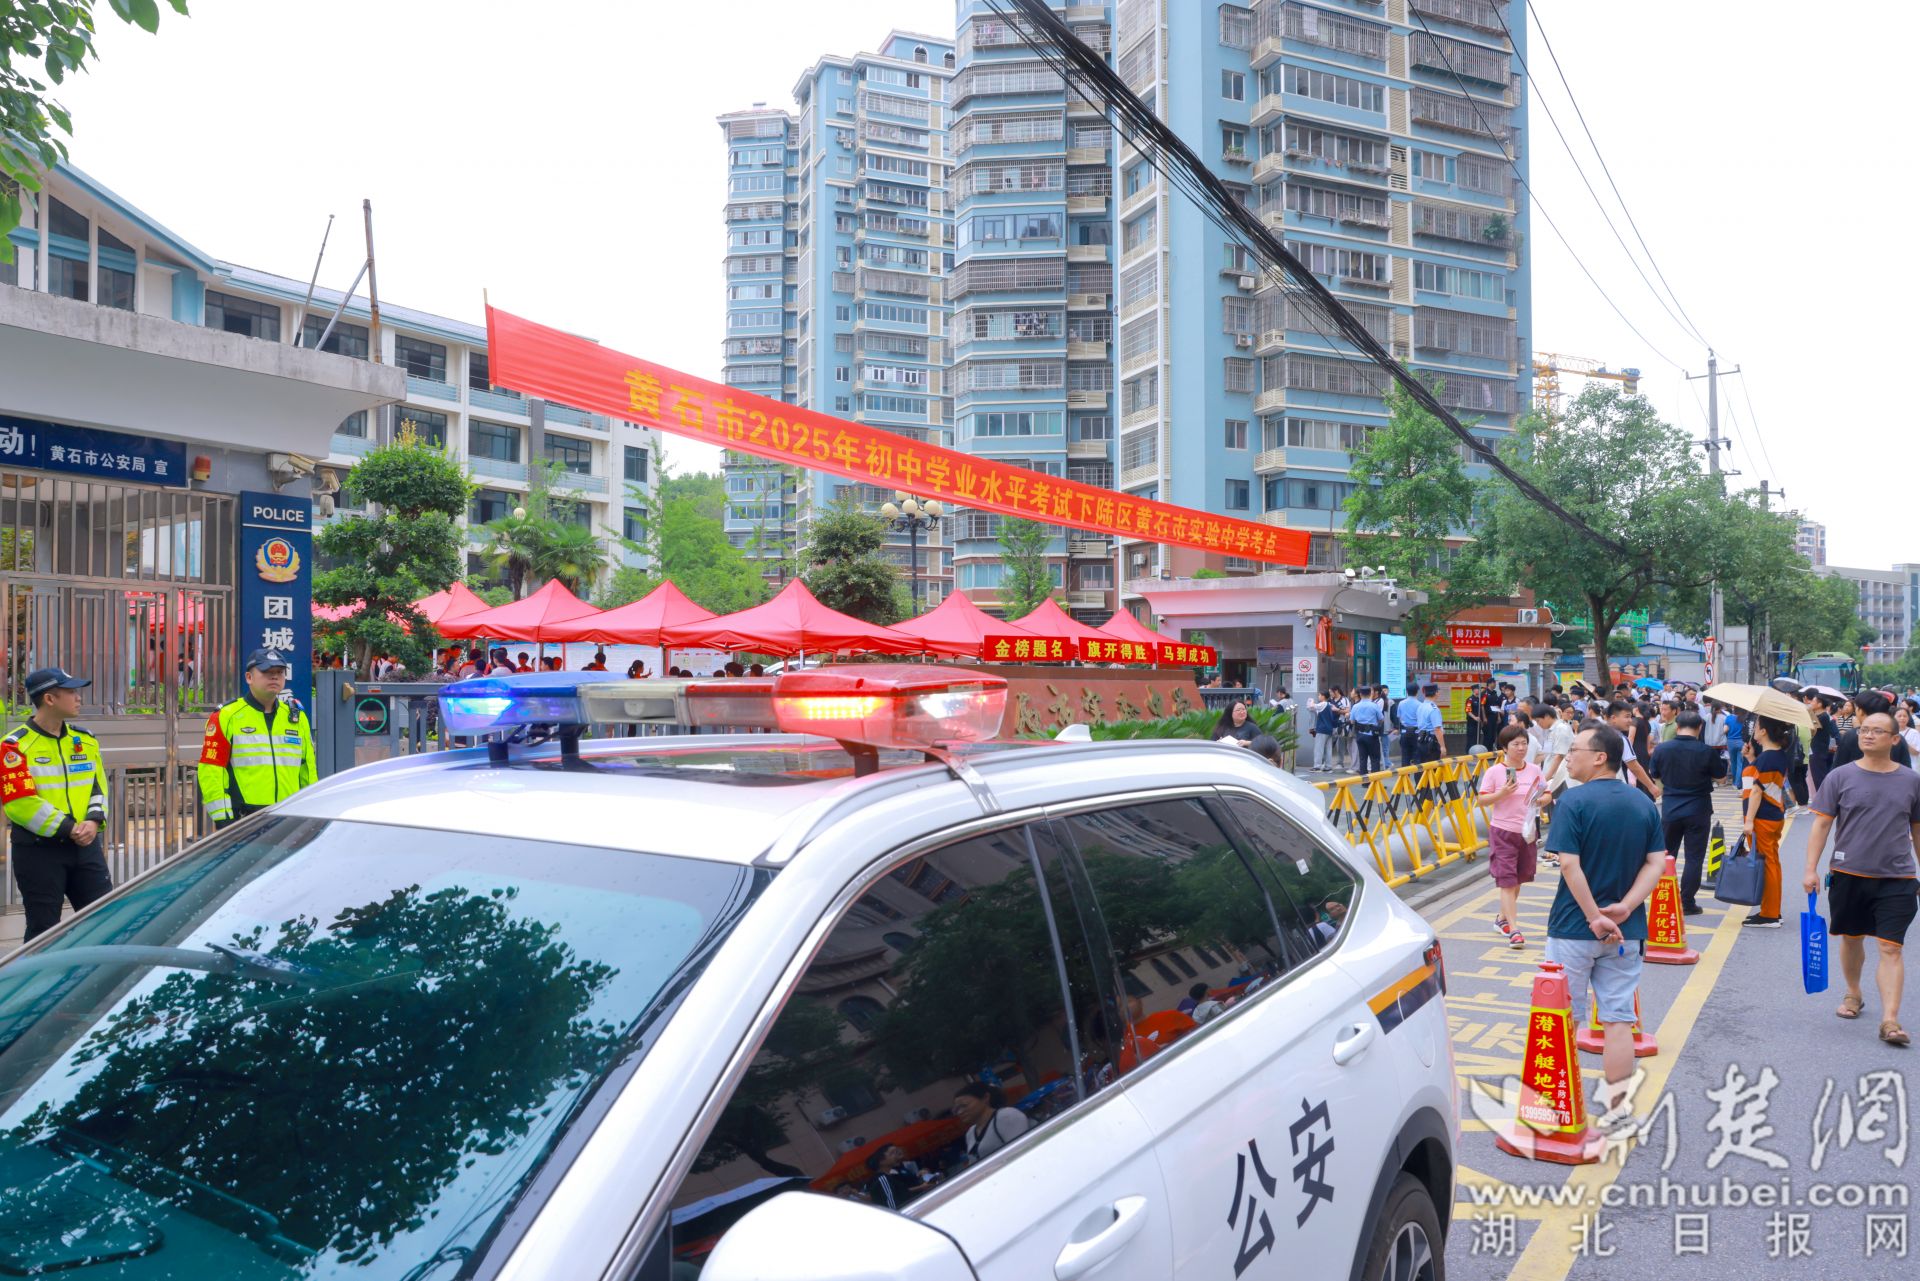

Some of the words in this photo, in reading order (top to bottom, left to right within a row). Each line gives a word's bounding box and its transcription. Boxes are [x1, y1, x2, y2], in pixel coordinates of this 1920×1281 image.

[51, 445, 146, 473] 黄石市公安局
[154, 459, 168, 476] 宣
[623, 369, 1278, 557] 黄石市2025年初中学业水平考试下陆区黄石市实验中学考点
[253, 506, 305, 523] POLICE
[994, 639, 1063, 659] 金榜题名
[1087, 640, 1149, 661] 旗开得胜
[1163, 644, 1211, 665] 马到成功
[1656, 890, 1670, 943] 厨卫优品
[1534, 1014, 1557, 1106] 潜水艇地漏
[1227, 1097, 1335, 1280] 公安
